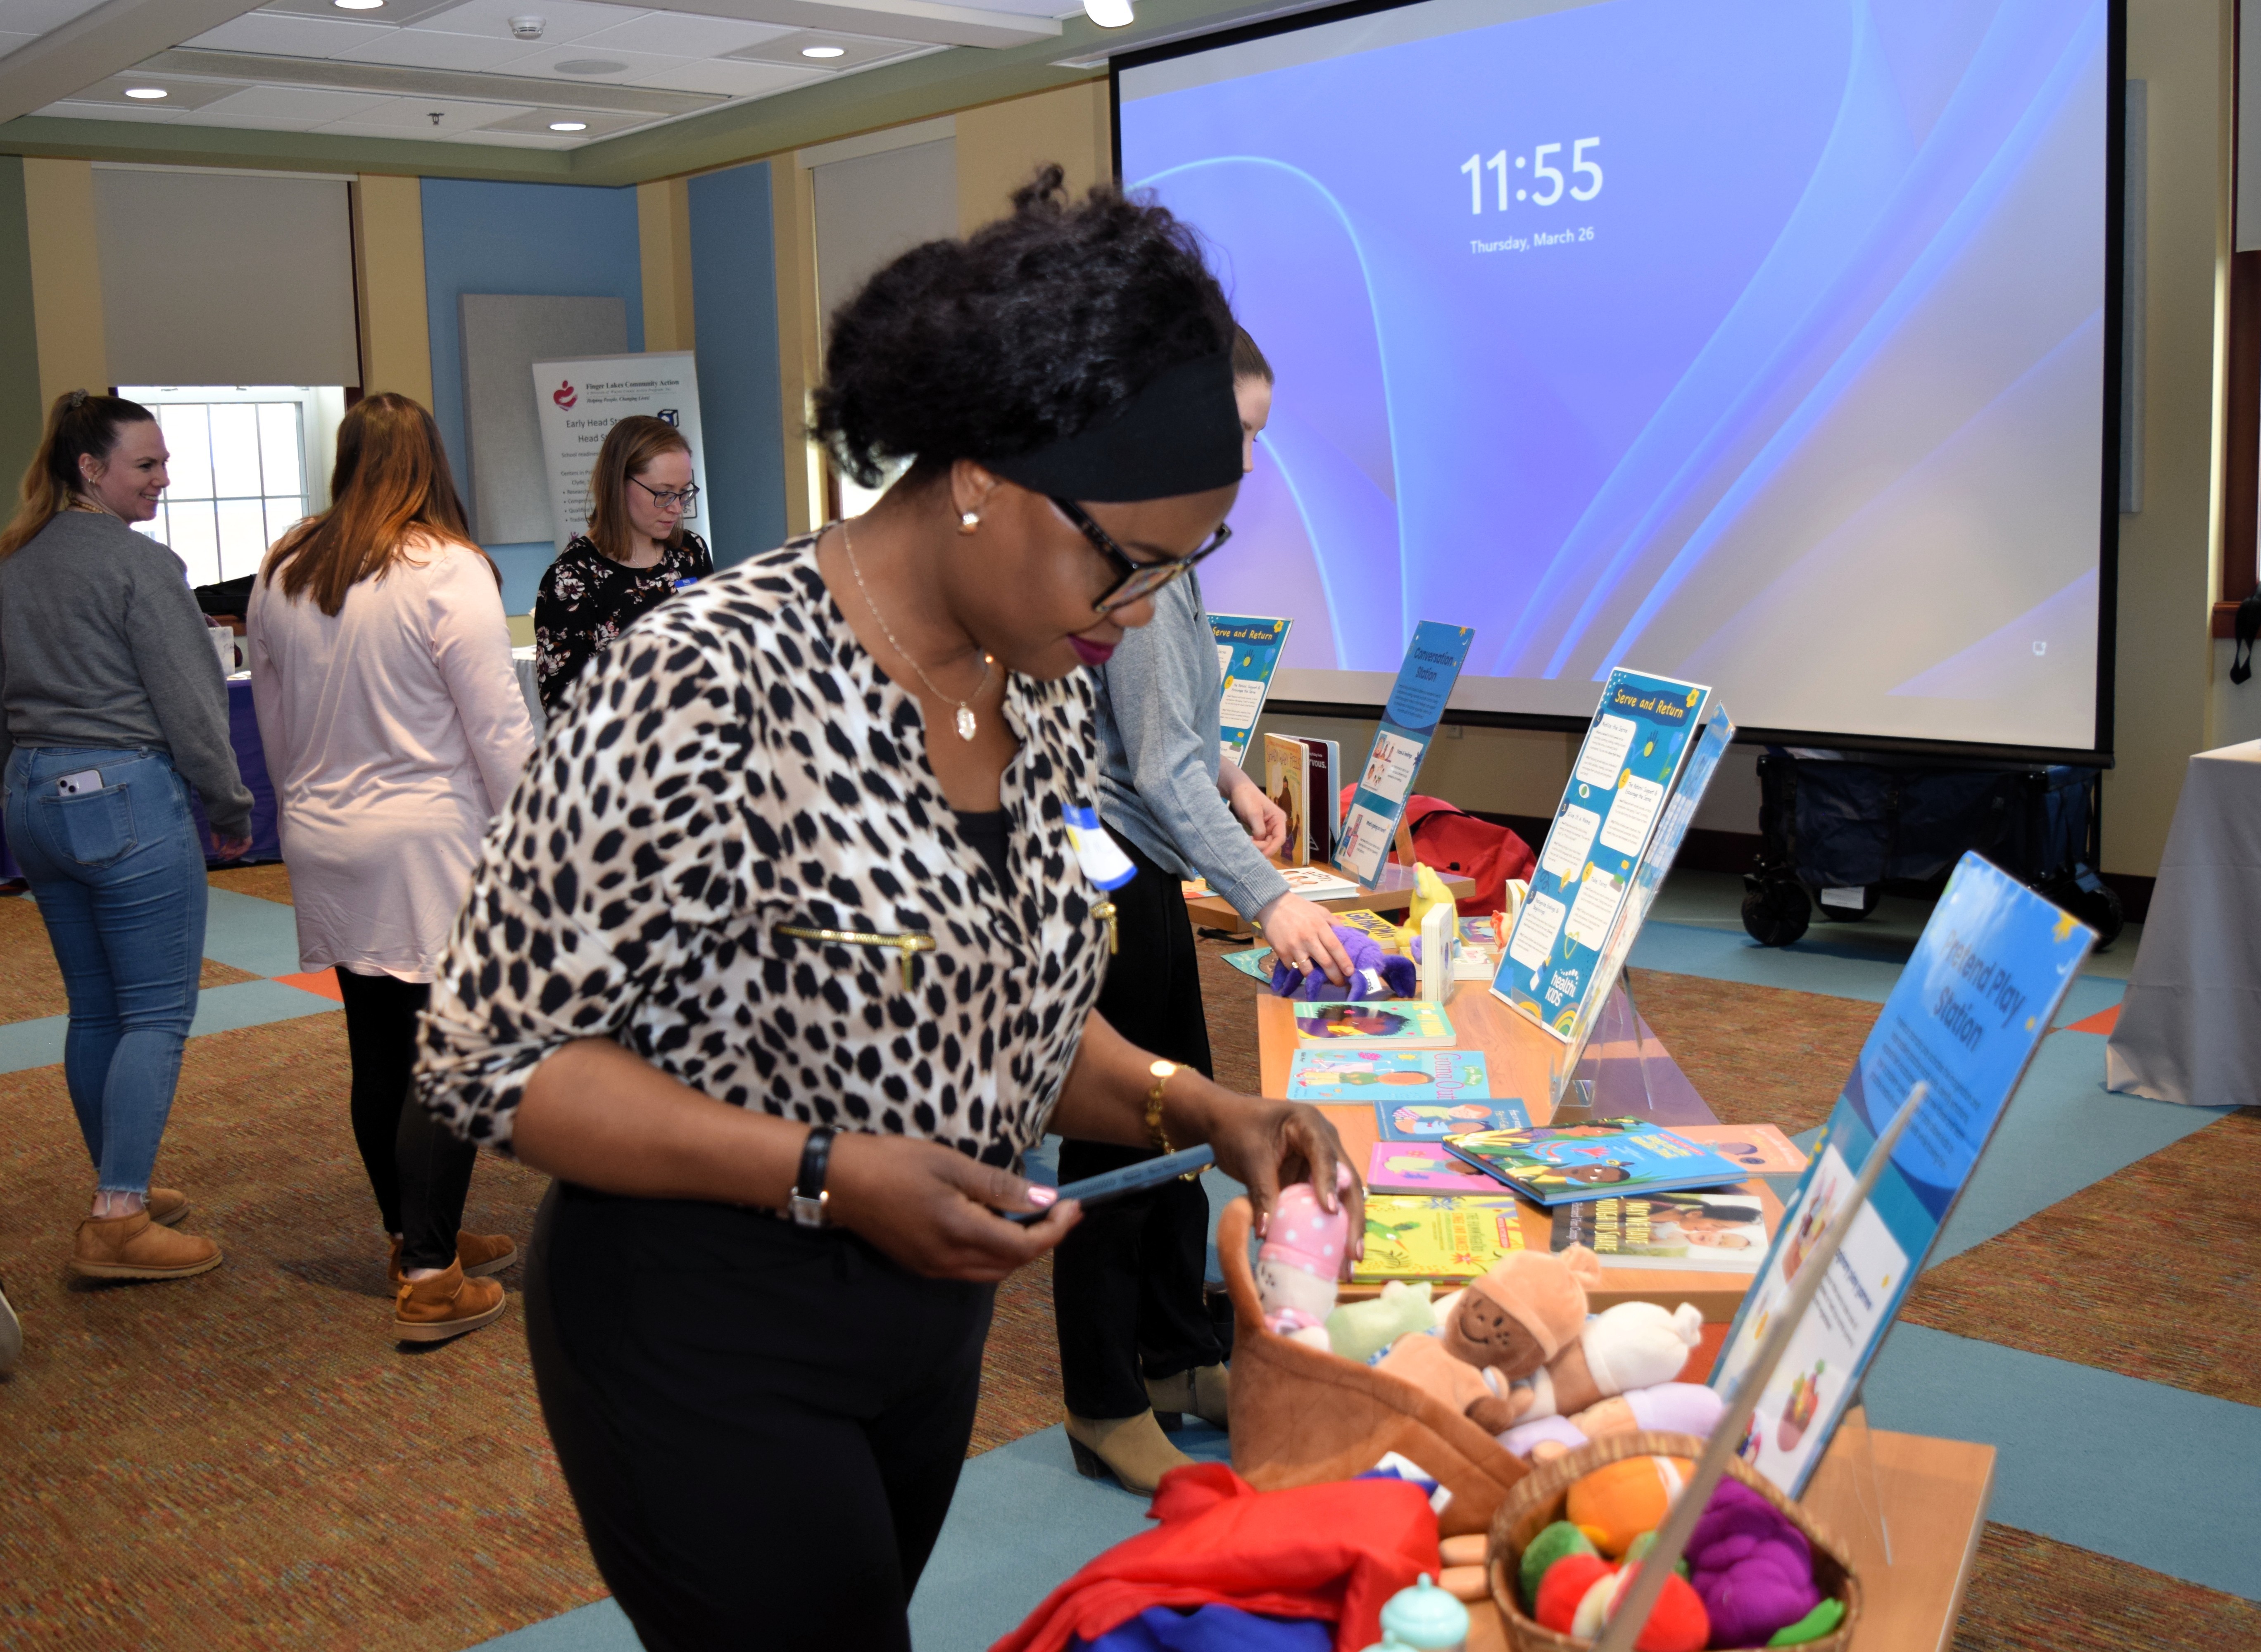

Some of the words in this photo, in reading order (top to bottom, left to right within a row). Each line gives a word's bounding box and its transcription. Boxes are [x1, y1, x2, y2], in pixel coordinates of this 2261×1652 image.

[1461, 136, 1603, 215] 11:55
[1470, 236, 1529, 254] Thursday,
[1534, 229, 1574, 247] March
[1578, 227, 1594, 242] 26
[566, 420, 585, 429] Early
[1213, 627, 1230, 637] Serve
[1234, 629, 1247, 637] and
[1249, 630, 1272, 640] Return
[1414, 647, 1454, 667] Conversation
[1415, 666, 1437, 682] Station
[1615, 689, 1637, 707] Serve
[1639, 698, 1656, 710] and
[1656, 700, 1684, 718] Return
[1309, 759, 1327, 769] rvous.
[1345, 911, 1396, 938] GRANDMA
[1551, 970, 1576, 998] healthi
[1940, 928, 1997, 992] Pretend
[1986, 968, 2026, 1029] Play
[1545, 986, 1563, 1006] KIDS
[1933, 985, 1983, 1052] Station
[1434, 1053, 1461, 1079] Going
[1436, 1081, 1464, 1099] Out
[1571, 1202, 1583, 1217] Richard
[1595, 1198, 1618, 1221] NOUGH
[1570, 1218, 1582, 1226] Van
[1566, 1227, 1581, 1239] Camp
[1594, 1230, 1621, 1251] SHARE
